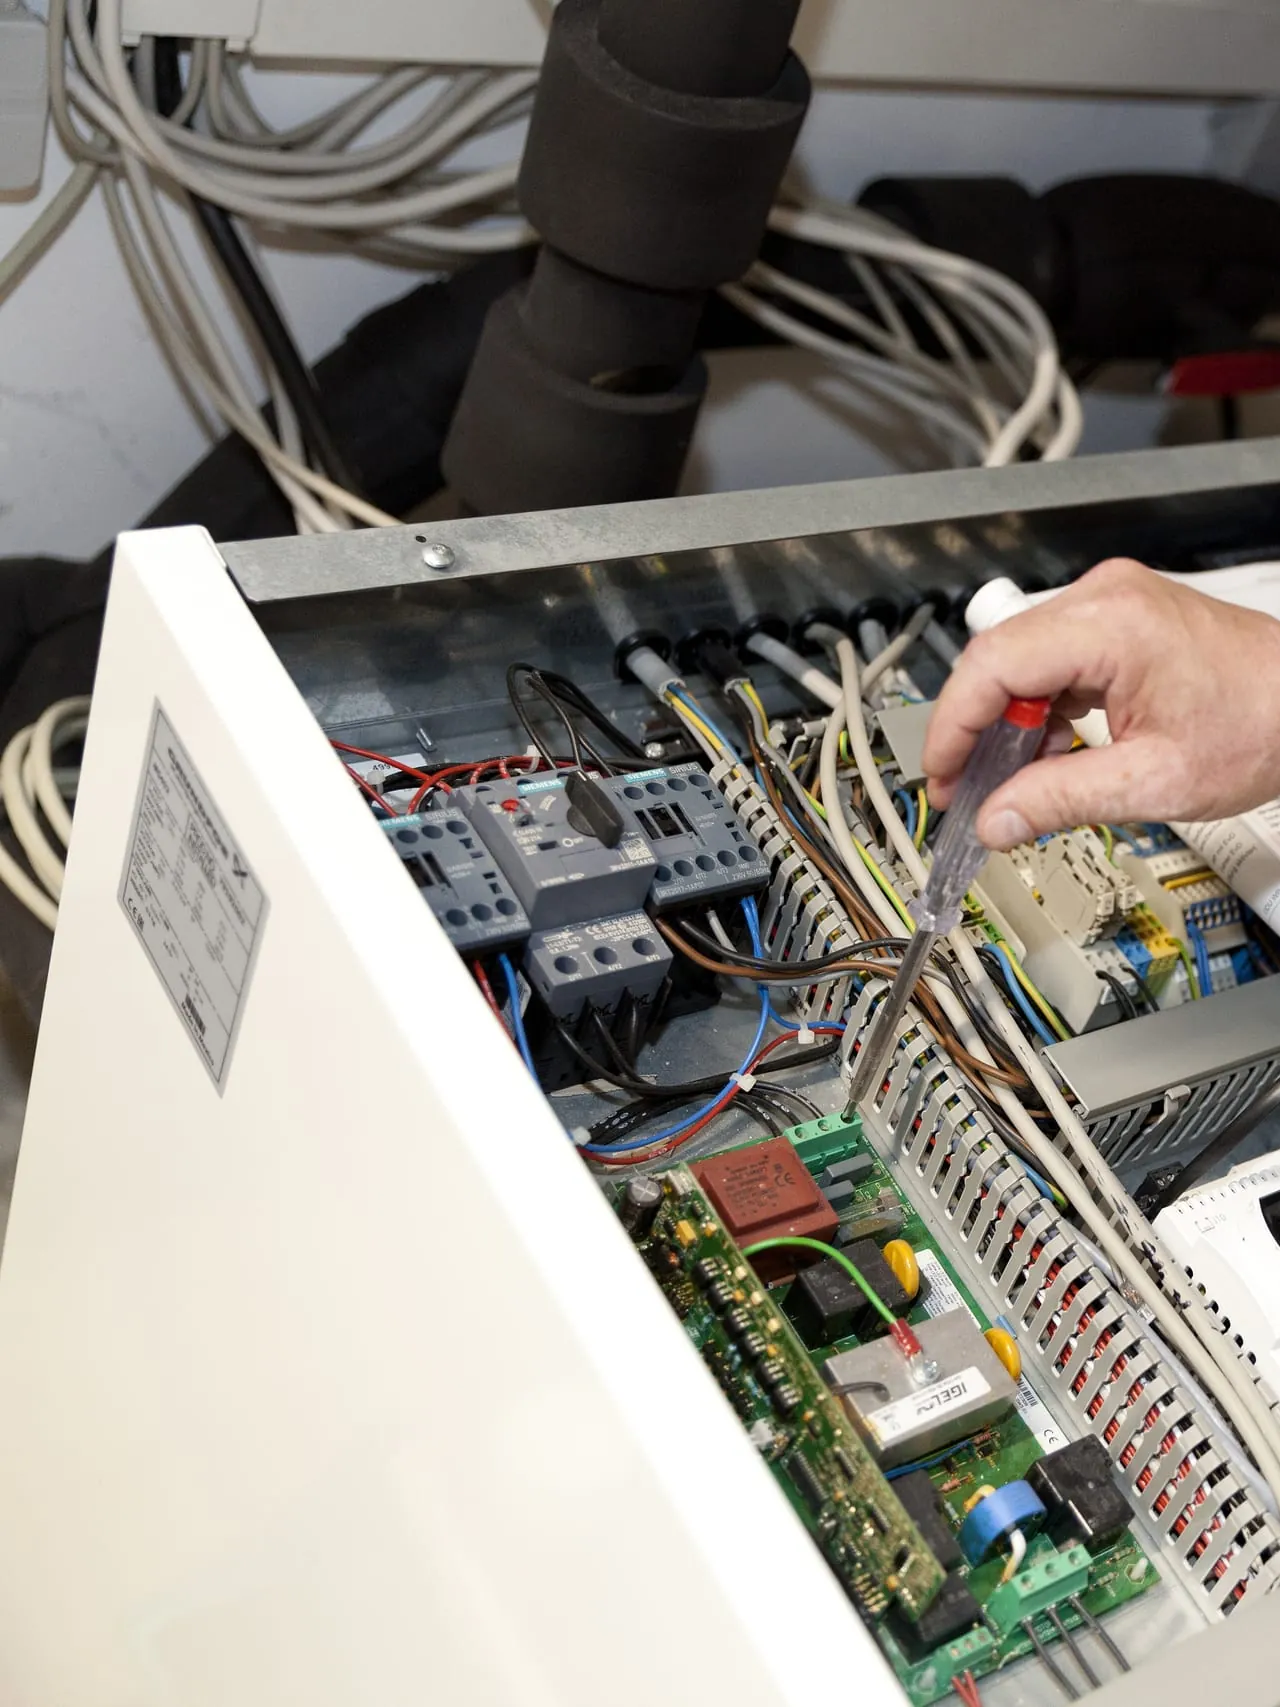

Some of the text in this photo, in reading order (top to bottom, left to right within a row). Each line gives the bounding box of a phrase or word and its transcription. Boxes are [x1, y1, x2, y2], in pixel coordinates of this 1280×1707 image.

[627, 767, 665, 781] SIEMENS
[523, 778, 563, 793] SIEMENS
[931, 1382, 967, 1405] IGEL
